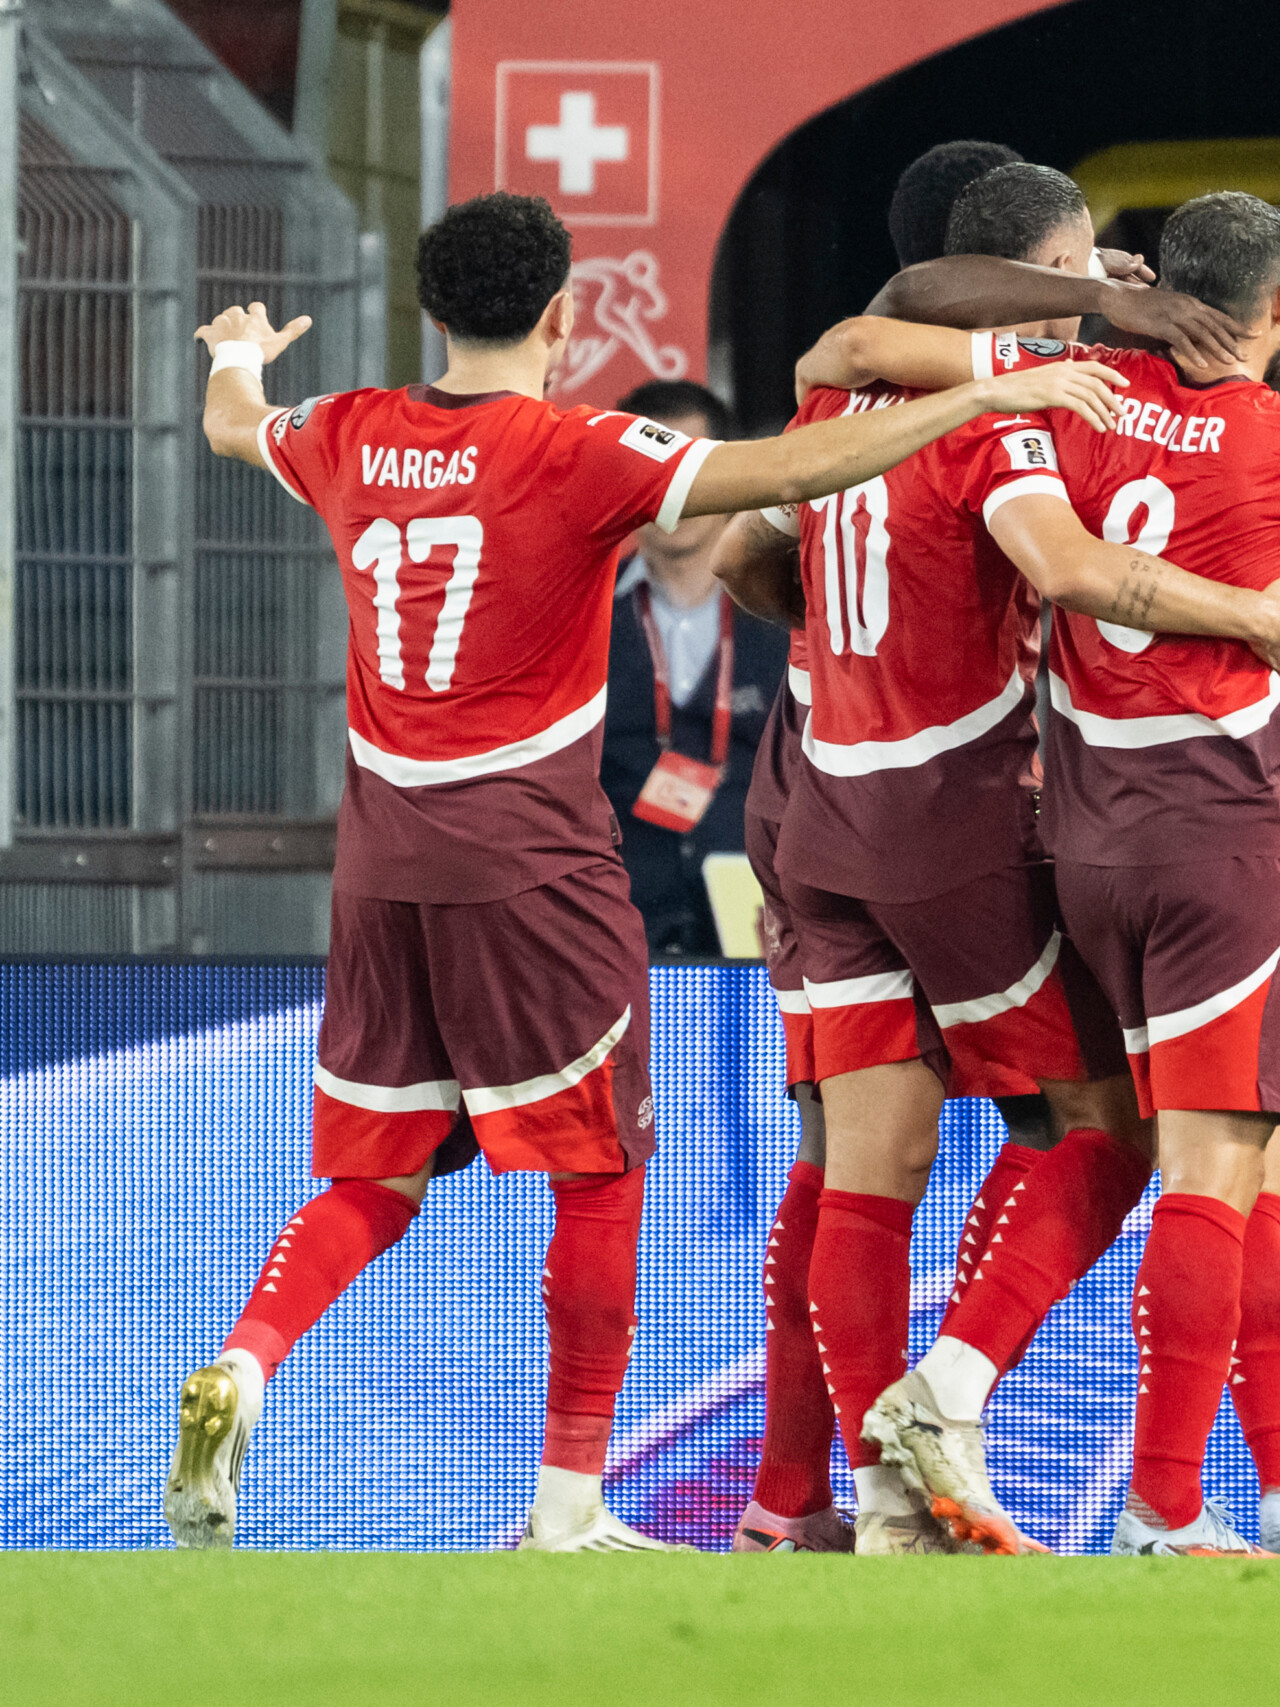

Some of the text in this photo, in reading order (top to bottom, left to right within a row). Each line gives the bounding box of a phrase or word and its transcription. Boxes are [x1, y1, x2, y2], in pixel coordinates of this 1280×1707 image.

[361, 444, 477, 489] VARGAS
[351, 514, 484, 692] 17
[809, 474, 892, 657] 10
